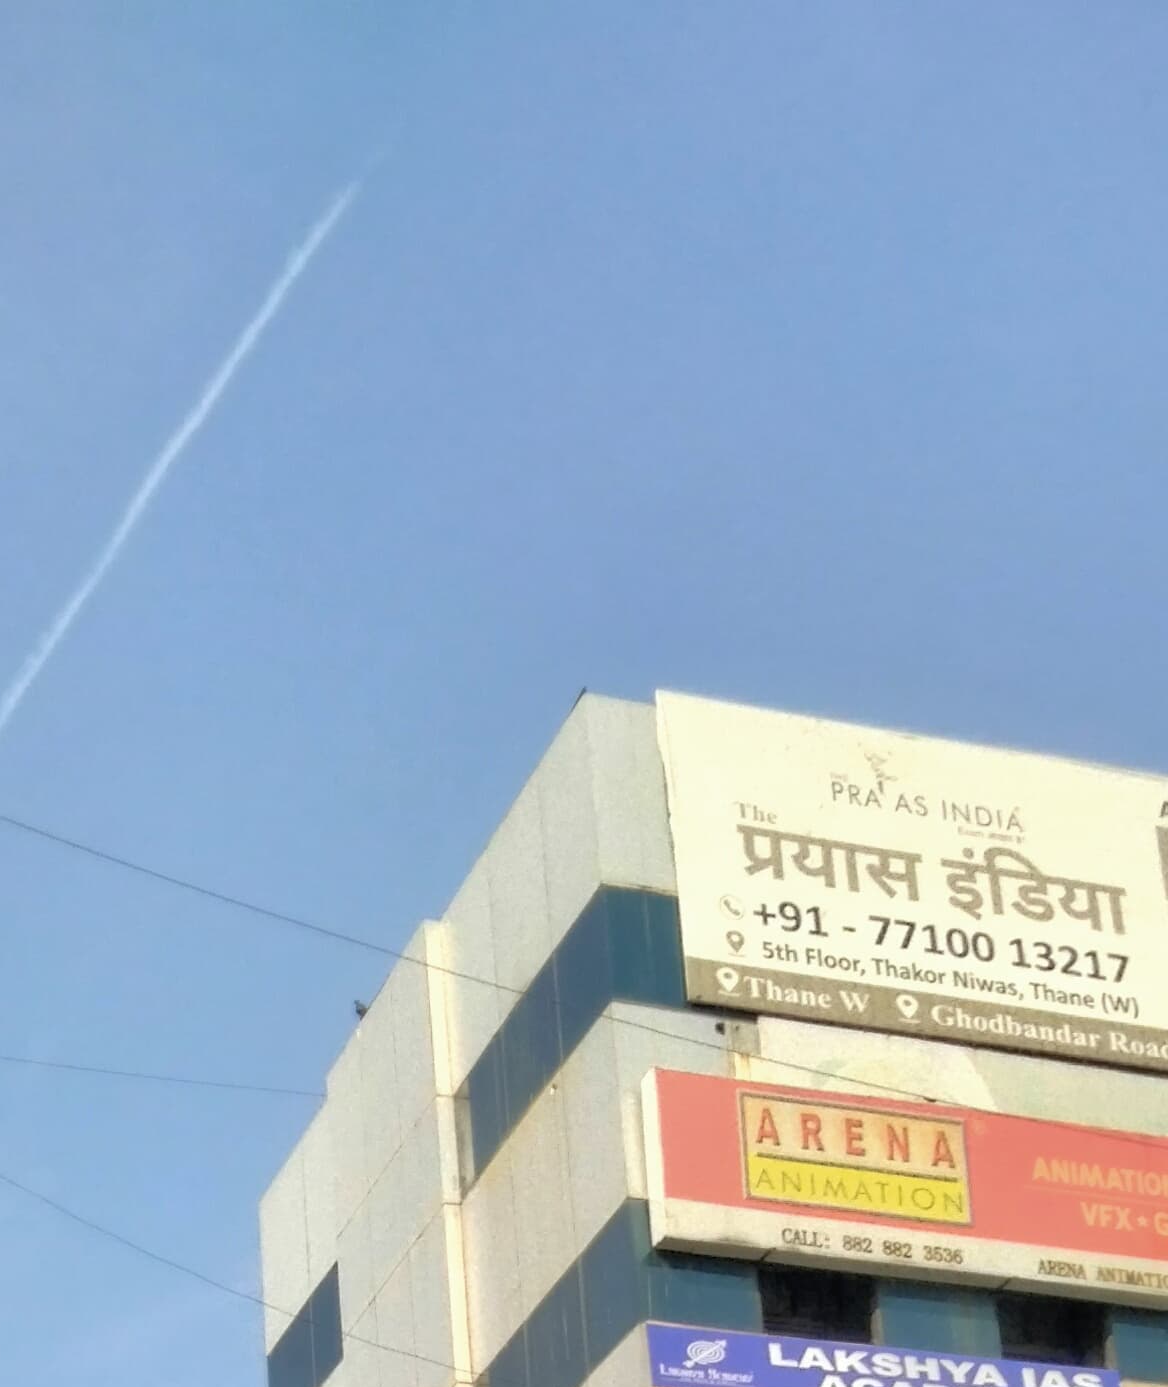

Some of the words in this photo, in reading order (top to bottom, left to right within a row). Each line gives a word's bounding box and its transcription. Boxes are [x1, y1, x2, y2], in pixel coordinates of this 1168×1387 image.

[736, 822, 922, 903] प्रयास
[940, 845, 1128, 935] इंडिया
[869, 915, 996, 962] 77100
[1008, 938, 1130, 984] 13217
[743, 976, 832, 1010] Thane
[762, 941, 799, 964] 5th
[872, 958, 946, 985] Thakor
[1029, 982, 1095, 1010] Thane
[931, 1005, 1100, 1050] Ghodbandar
[756, 1107, 957, 1169] ARENA
[755, 1167, 965, 1214] ANIMATION
[781, 1227, 831, 1250] CALL:
[843, 1235, 873, 1254] 882
[882, 1240, 913, 1259] 882
[923, 1246, 964, 1265] 3536
[1038, 1259, 1088, 1280] ARENA
[768, 1342, 1009, 1387] LAKSHYA
